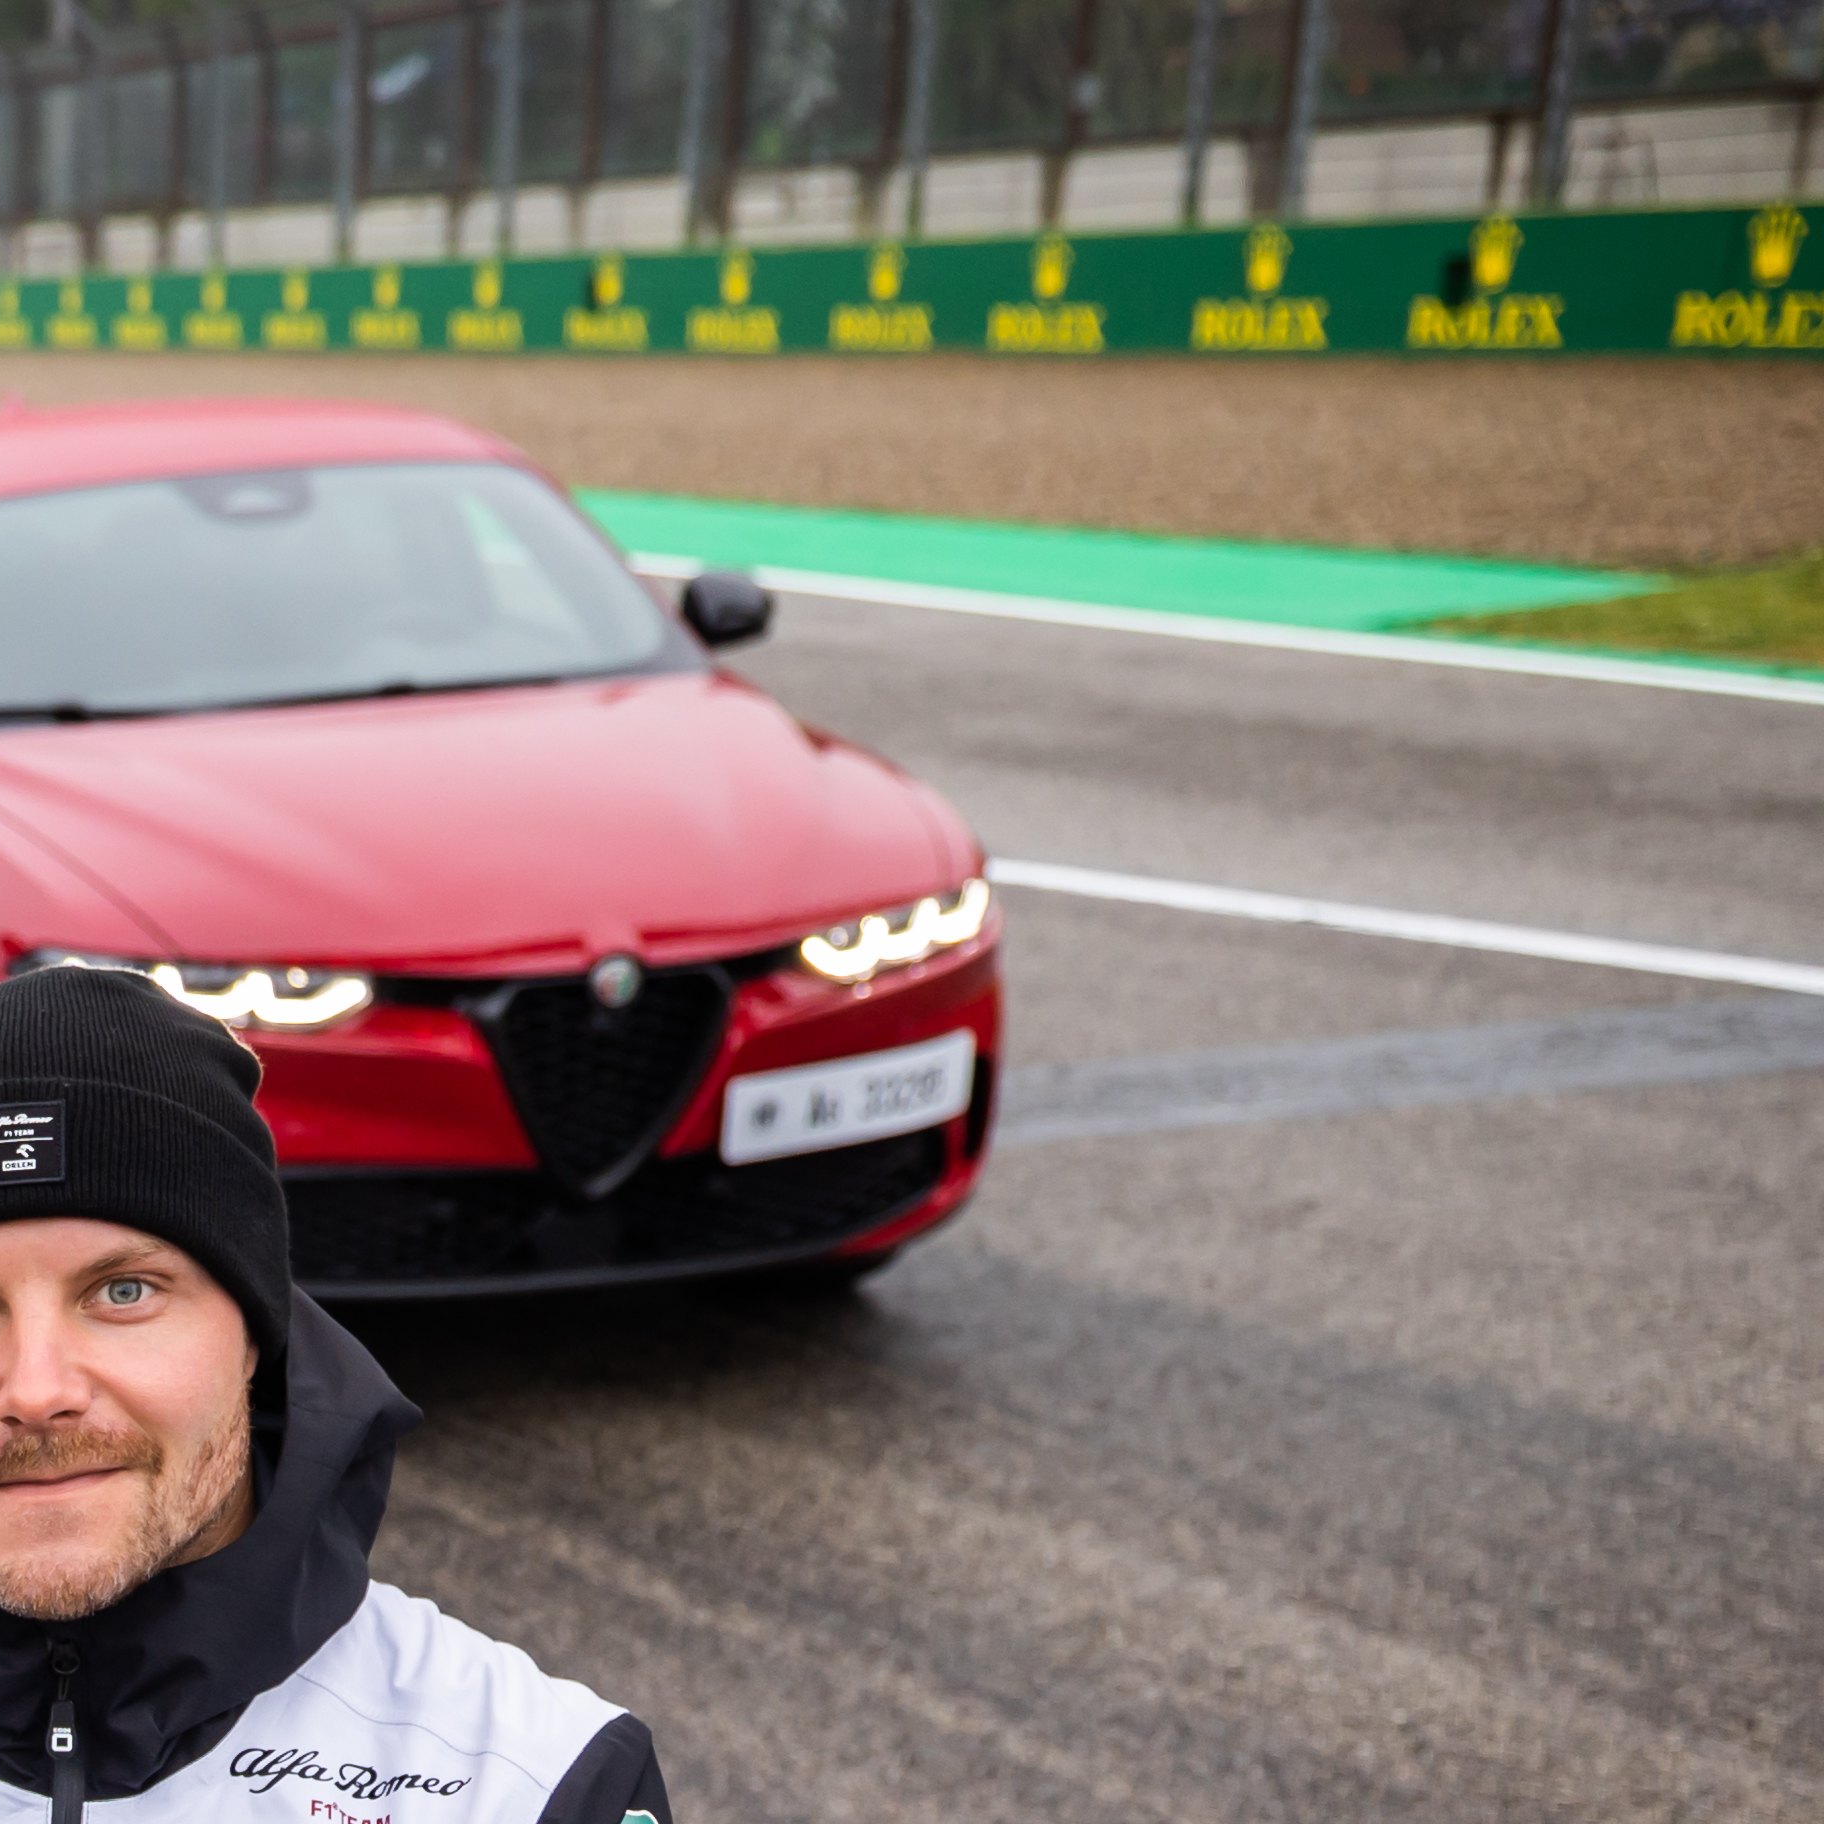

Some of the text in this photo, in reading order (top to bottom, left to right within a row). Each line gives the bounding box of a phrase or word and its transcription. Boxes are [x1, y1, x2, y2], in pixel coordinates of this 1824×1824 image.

[1672, 290, 1824, 348] ROLE
[229, 1747, 473, 1801] Alfa Romeo
